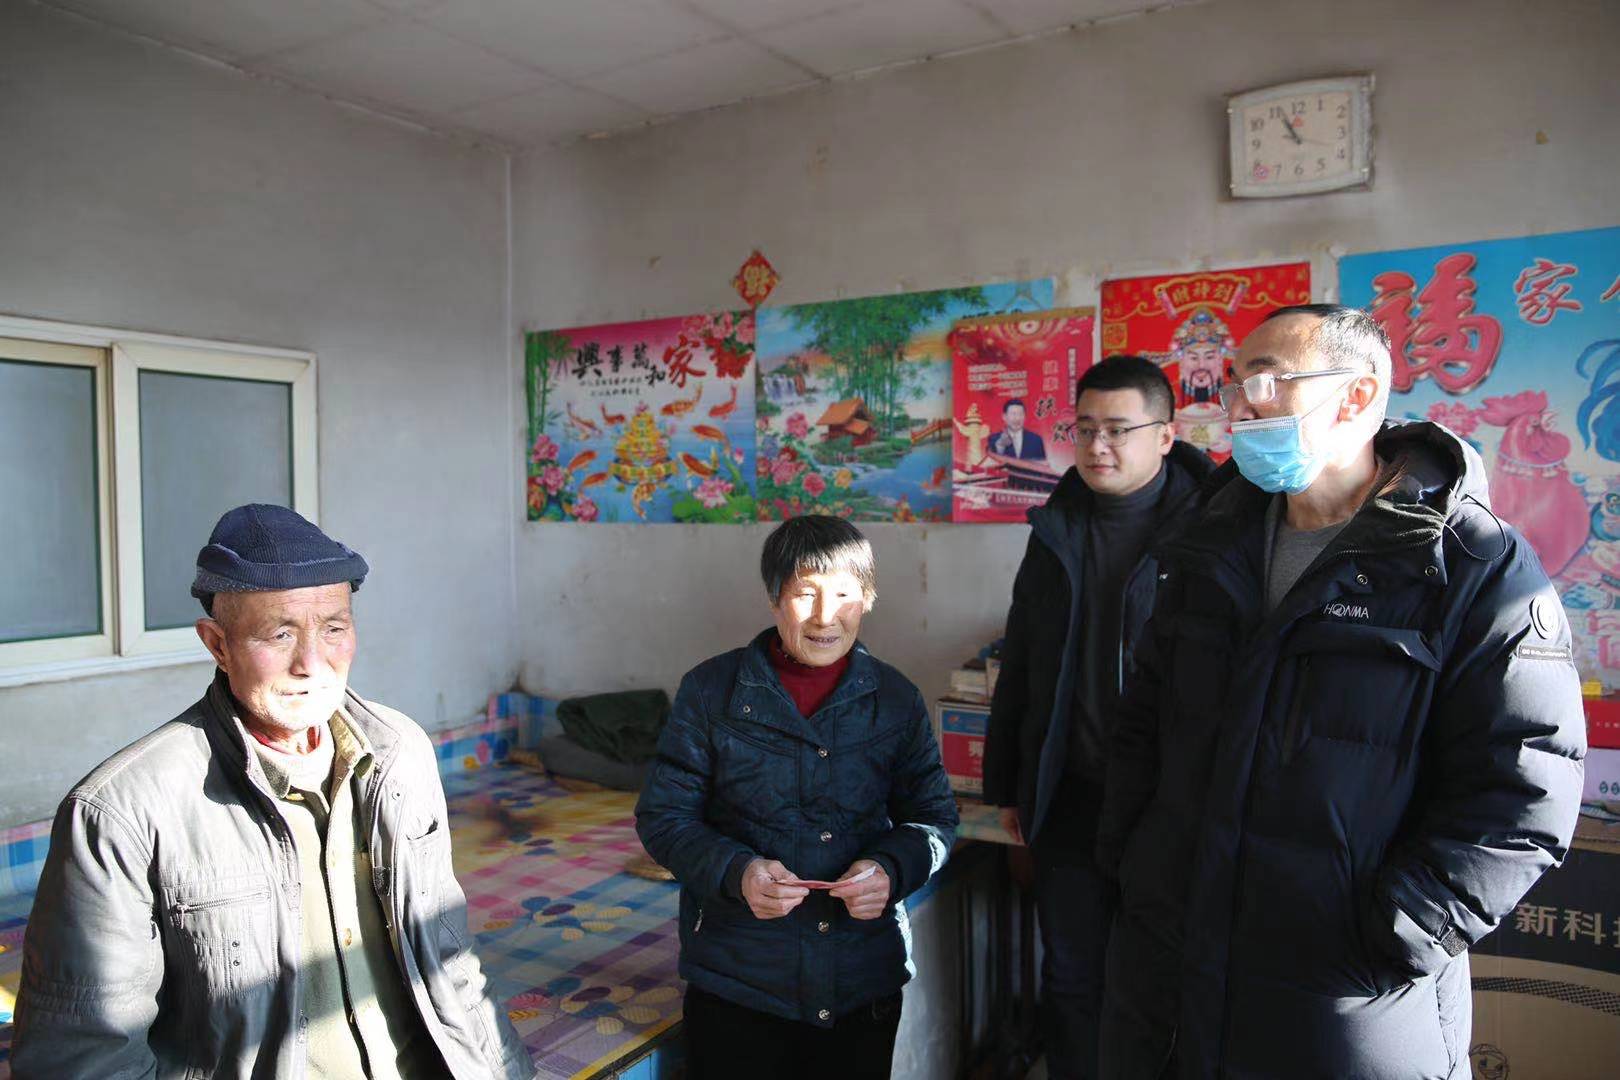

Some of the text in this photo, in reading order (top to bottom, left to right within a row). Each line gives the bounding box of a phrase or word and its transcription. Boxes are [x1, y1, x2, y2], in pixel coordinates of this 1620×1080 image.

[1291, 102, 1306, 115] 12
[1336, 105, 1346, 119] 2
[1250, 118, 1265, 132] 10
[1336, 126, 1346, 140] 3
[1251, 138, 1261, 150] 9
[1294, 162, 1304, 176] 6
[1316, 157, 1326, 172] 5
[1370, 252, 1504, 397] 福
[1323, 602, 1370, 620] HONMA
